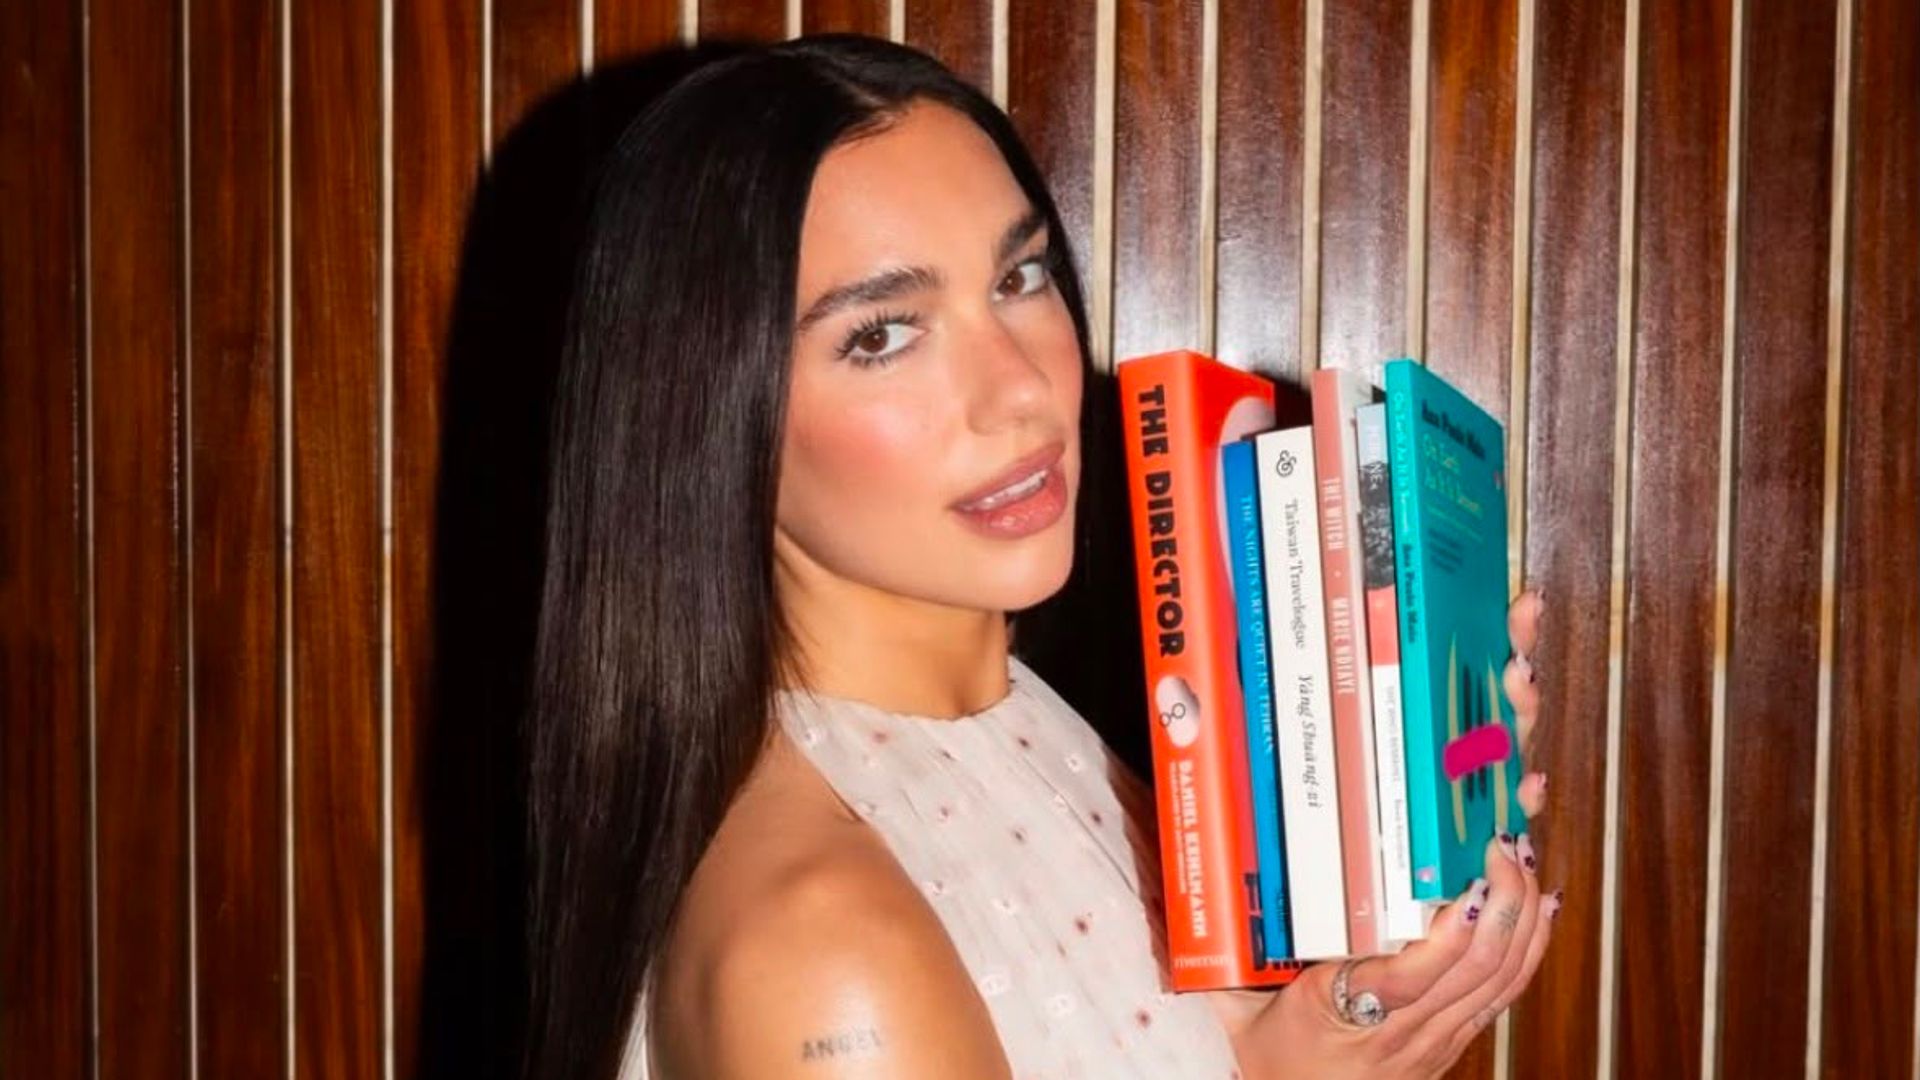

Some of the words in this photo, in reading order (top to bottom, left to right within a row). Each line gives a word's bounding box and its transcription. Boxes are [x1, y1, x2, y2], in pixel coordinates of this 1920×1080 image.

[1138, 384, 1168, 457] THE
[1240, 495, 1252, 521] THE
[1322, 477, 1342, 502] THE
[1285, 498, 1299, 557] Taiwan
[1325, 507, 1345, 551] WITCH
[1145, 471, 1185, 658] DIRECTOR
[1244, 529, 1259, 586] NIGHTS
[1402, 544, 1413, 568] Ana
[1249, 590, 1262, 614] ARE
[1290, 560, 1306, 648] Travelogue
[1332, 597, 1351, 640] MARIE
[1250, 620, 1267, 666] QUIET
[1257, 672, 1269, 688] IN
[1335, 646, 1356, 694] NDIAYE
[1258, 694, 1273, 755] TEHRAN
[1178, 760, 1198, 829] DANIEL
[1184, 831, 1208, 937] KEHLMANN
